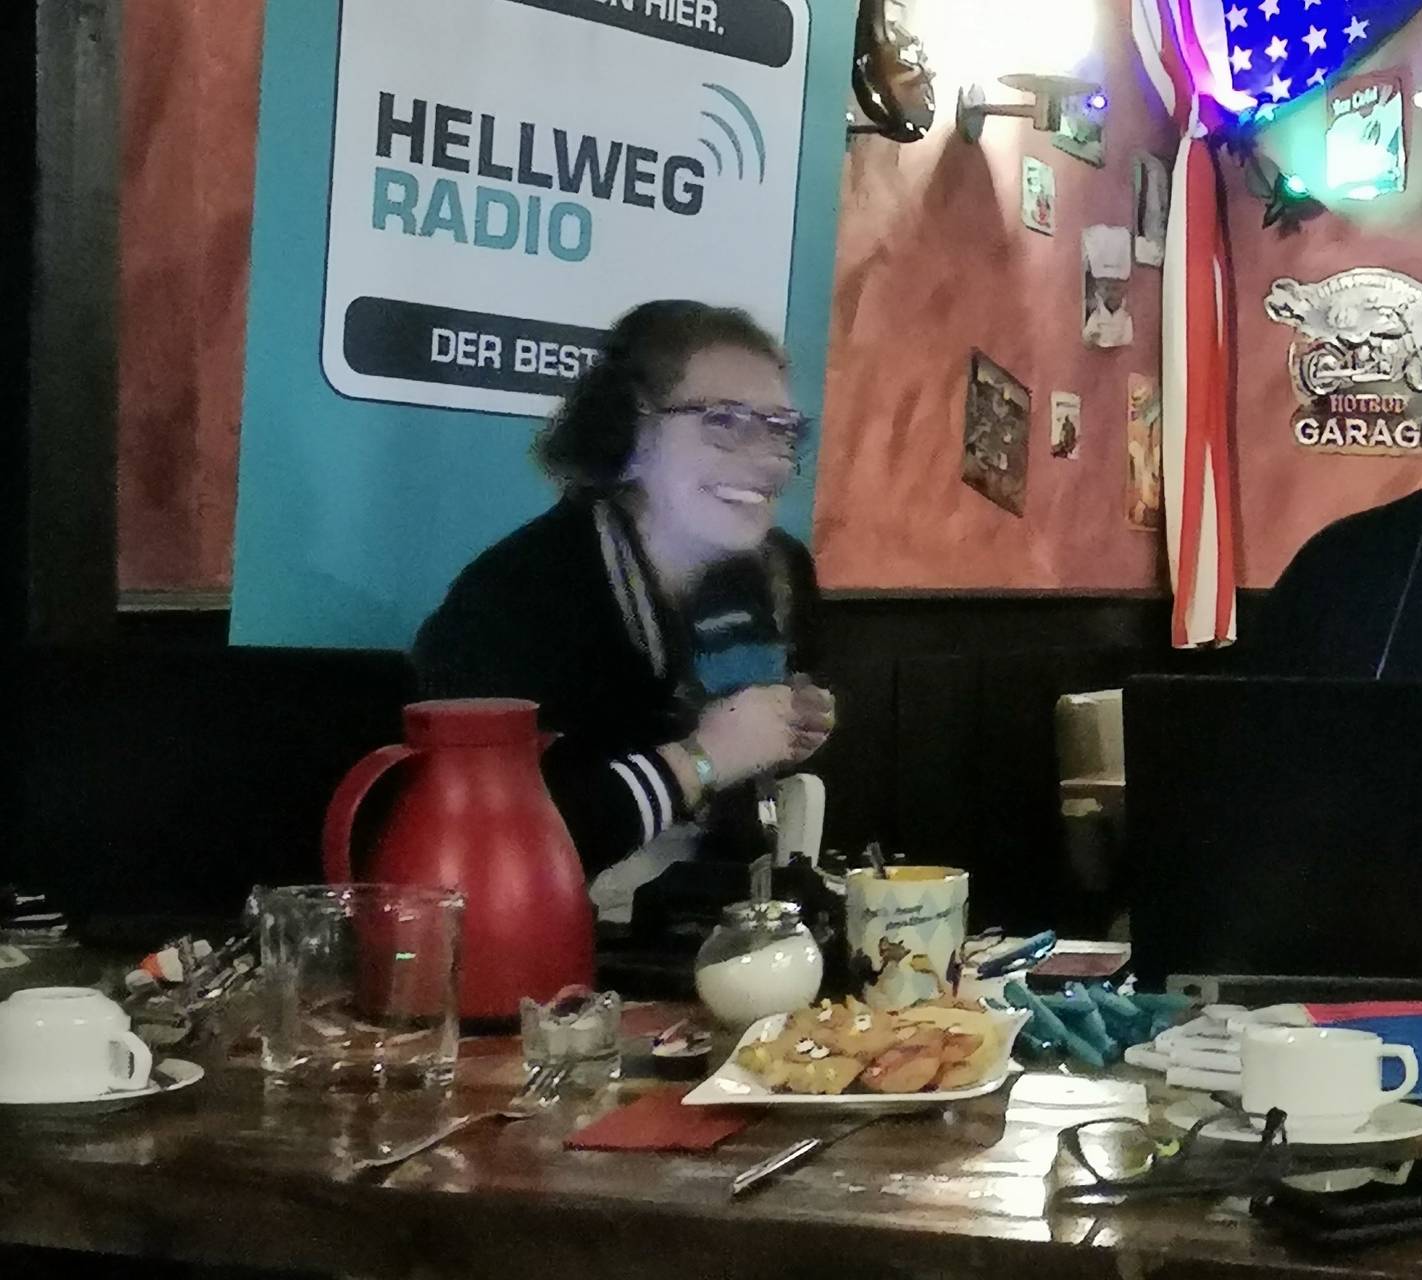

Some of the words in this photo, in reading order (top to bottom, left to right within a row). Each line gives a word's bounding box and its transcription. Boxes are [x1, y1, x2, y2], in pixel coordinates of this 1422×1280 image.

[376, 91, 705, 216] HELLWEG
[372, 166, 593, 263] RADIO
[431, 328, 502, 369] DER
